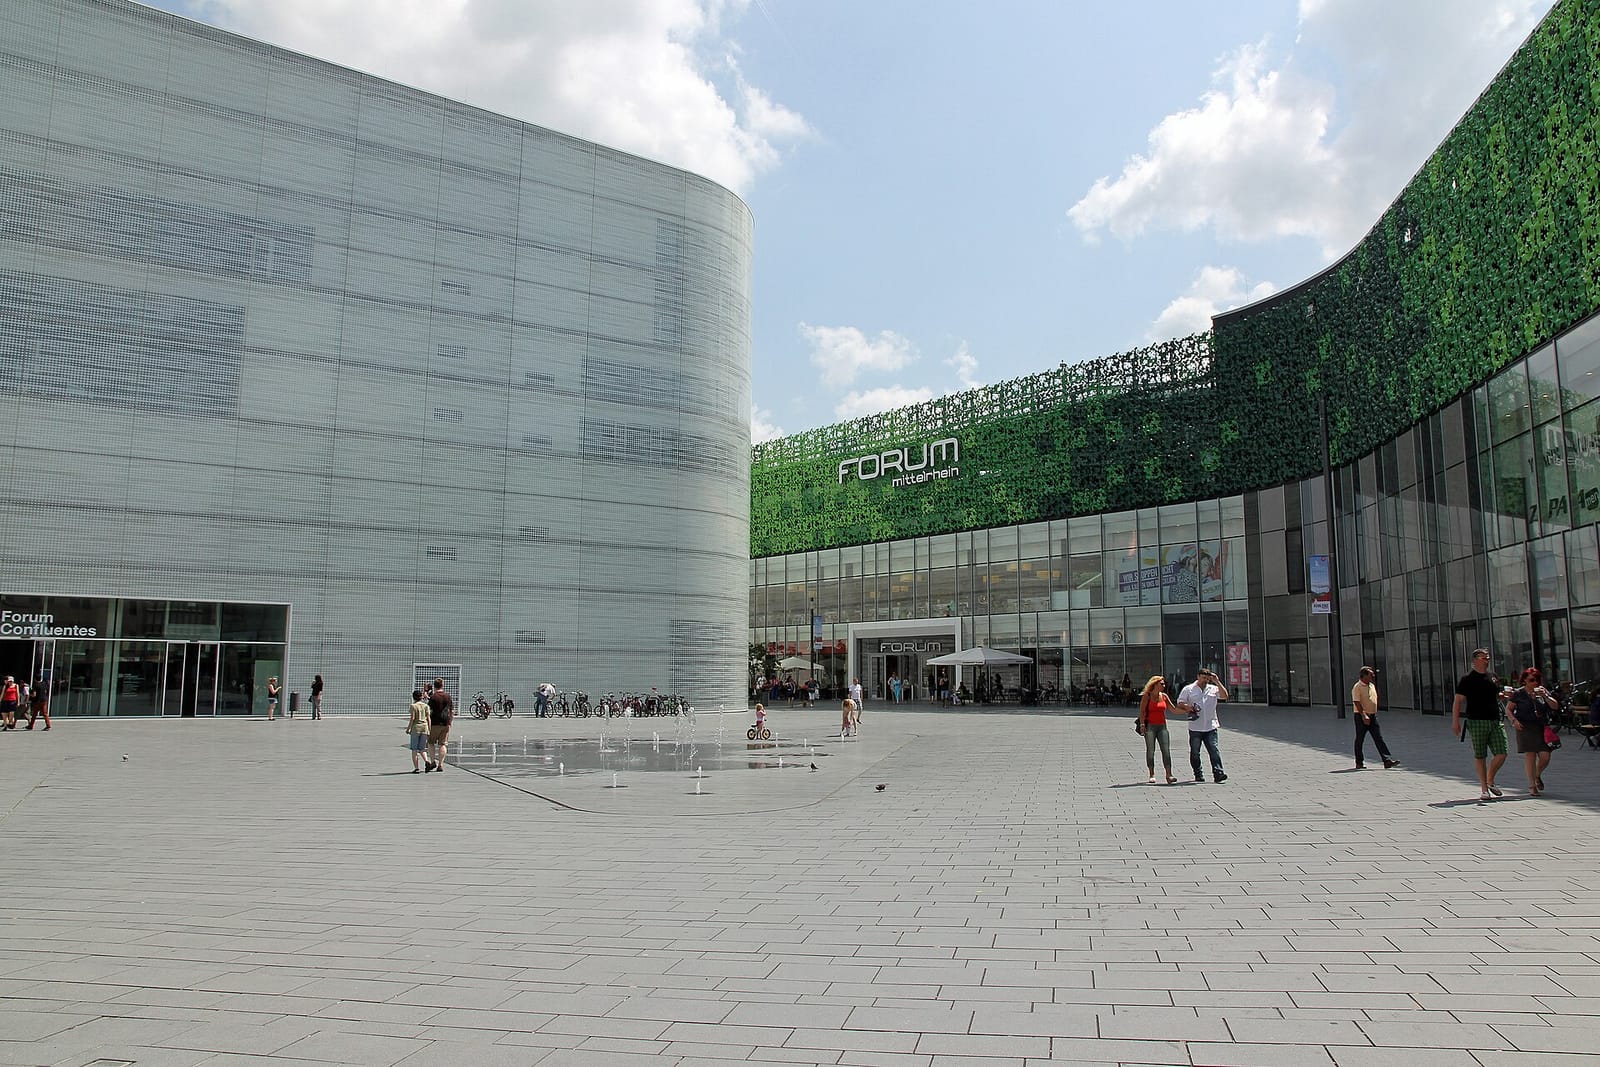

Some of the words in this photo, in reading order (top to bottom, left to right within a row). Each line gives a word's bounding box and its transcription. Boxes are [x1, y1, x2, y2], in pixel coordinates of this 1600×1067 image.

[838, 437, 959, 484] FORUM
[892, 465, 959, 488] mittelrhein
[1, 610, 53, 623] Forum
[0, 622, 97, 637] Confluentes
[880, 642, 941, 652] FORUM
